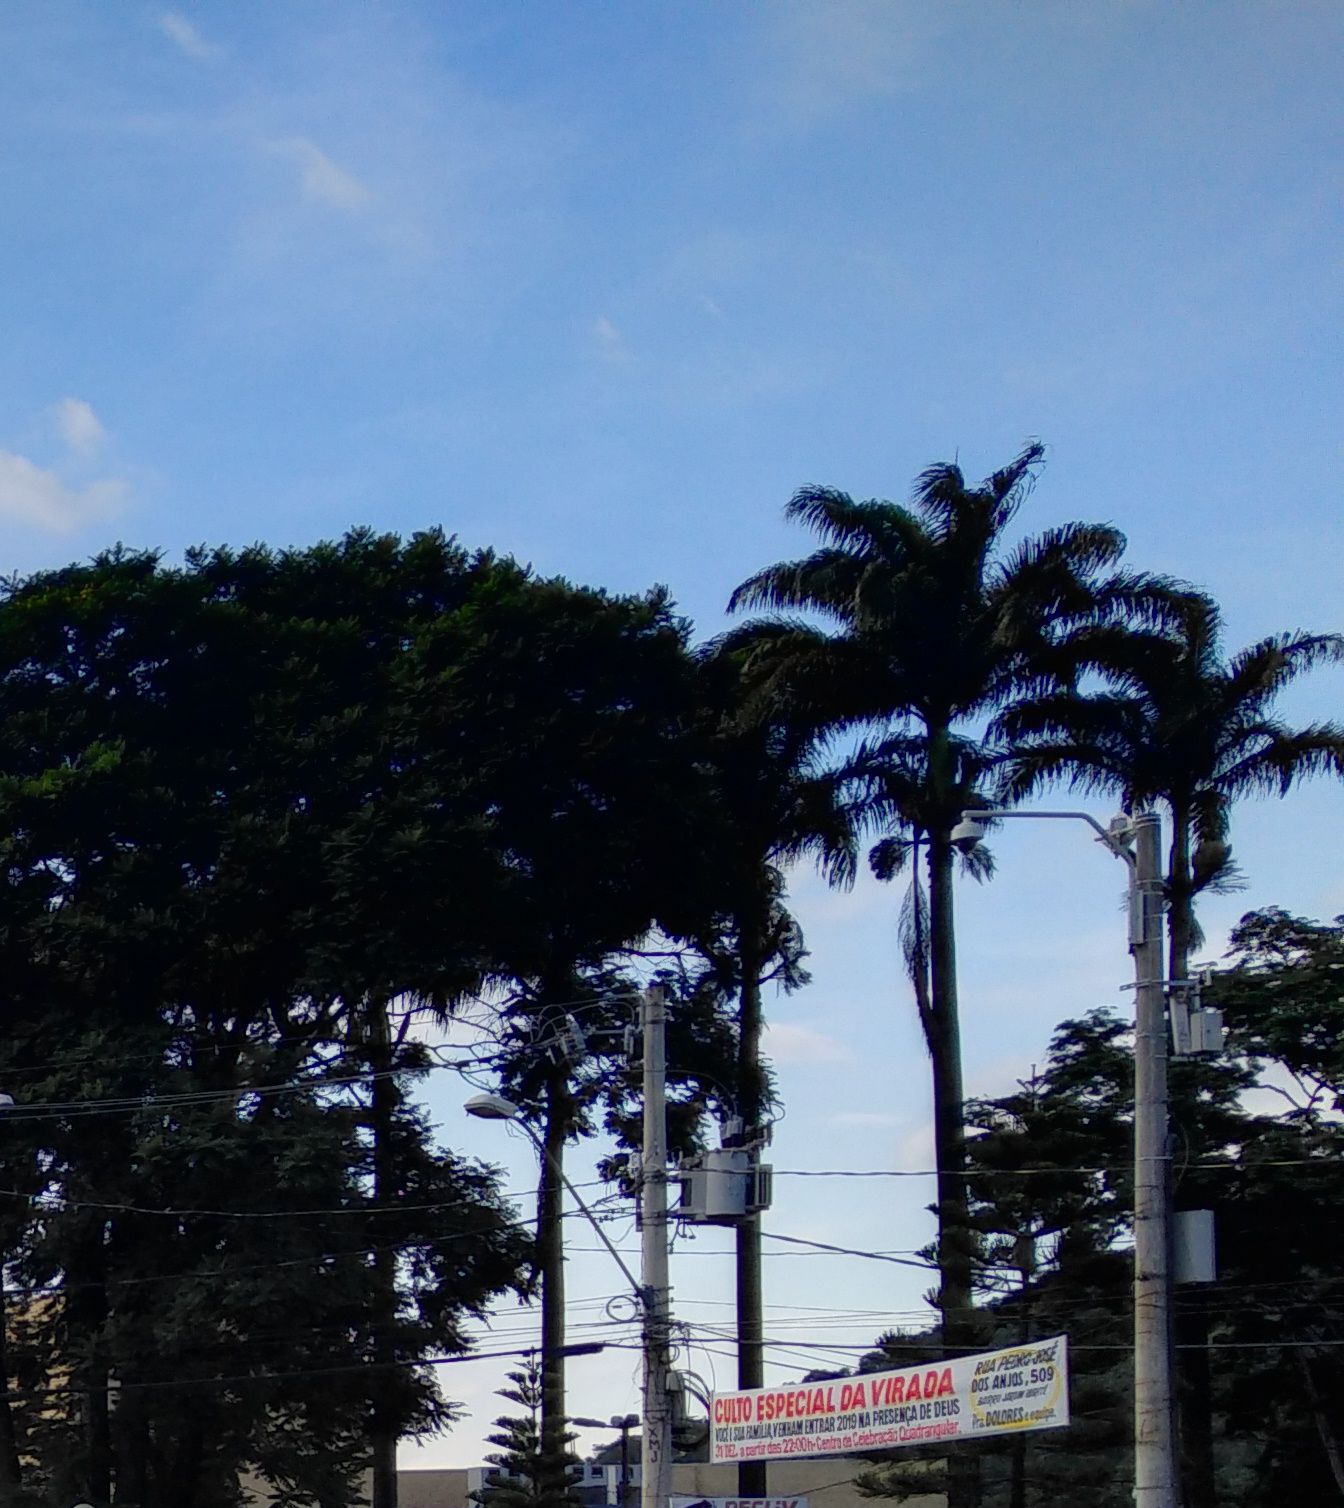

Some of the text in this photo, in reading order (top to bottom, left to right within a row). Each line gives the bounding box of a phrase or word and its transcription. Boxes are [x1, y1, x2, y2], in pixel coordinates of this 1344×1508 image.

[972, 1377, 989, 1392] DOS
[1030, 1366, 1054, 1383] 509
[974, 1359, 996, 1375] RUA
[715, 1367, 955, 1425] CULTO ESPECIAL DA VIRADA
[805, 1417, 835, 1434] ENTRAR
[837, 1414, 857, 1431] 2019
[858, 1412, 870, 1428] NA
[873, 1404, 917, 1427] PRESENÇA
[920, 1403, 931, 1420] DE
[934, 1398, 960, 1418] DEUS
[986, 1406, 1024, 1427] DOLORES
